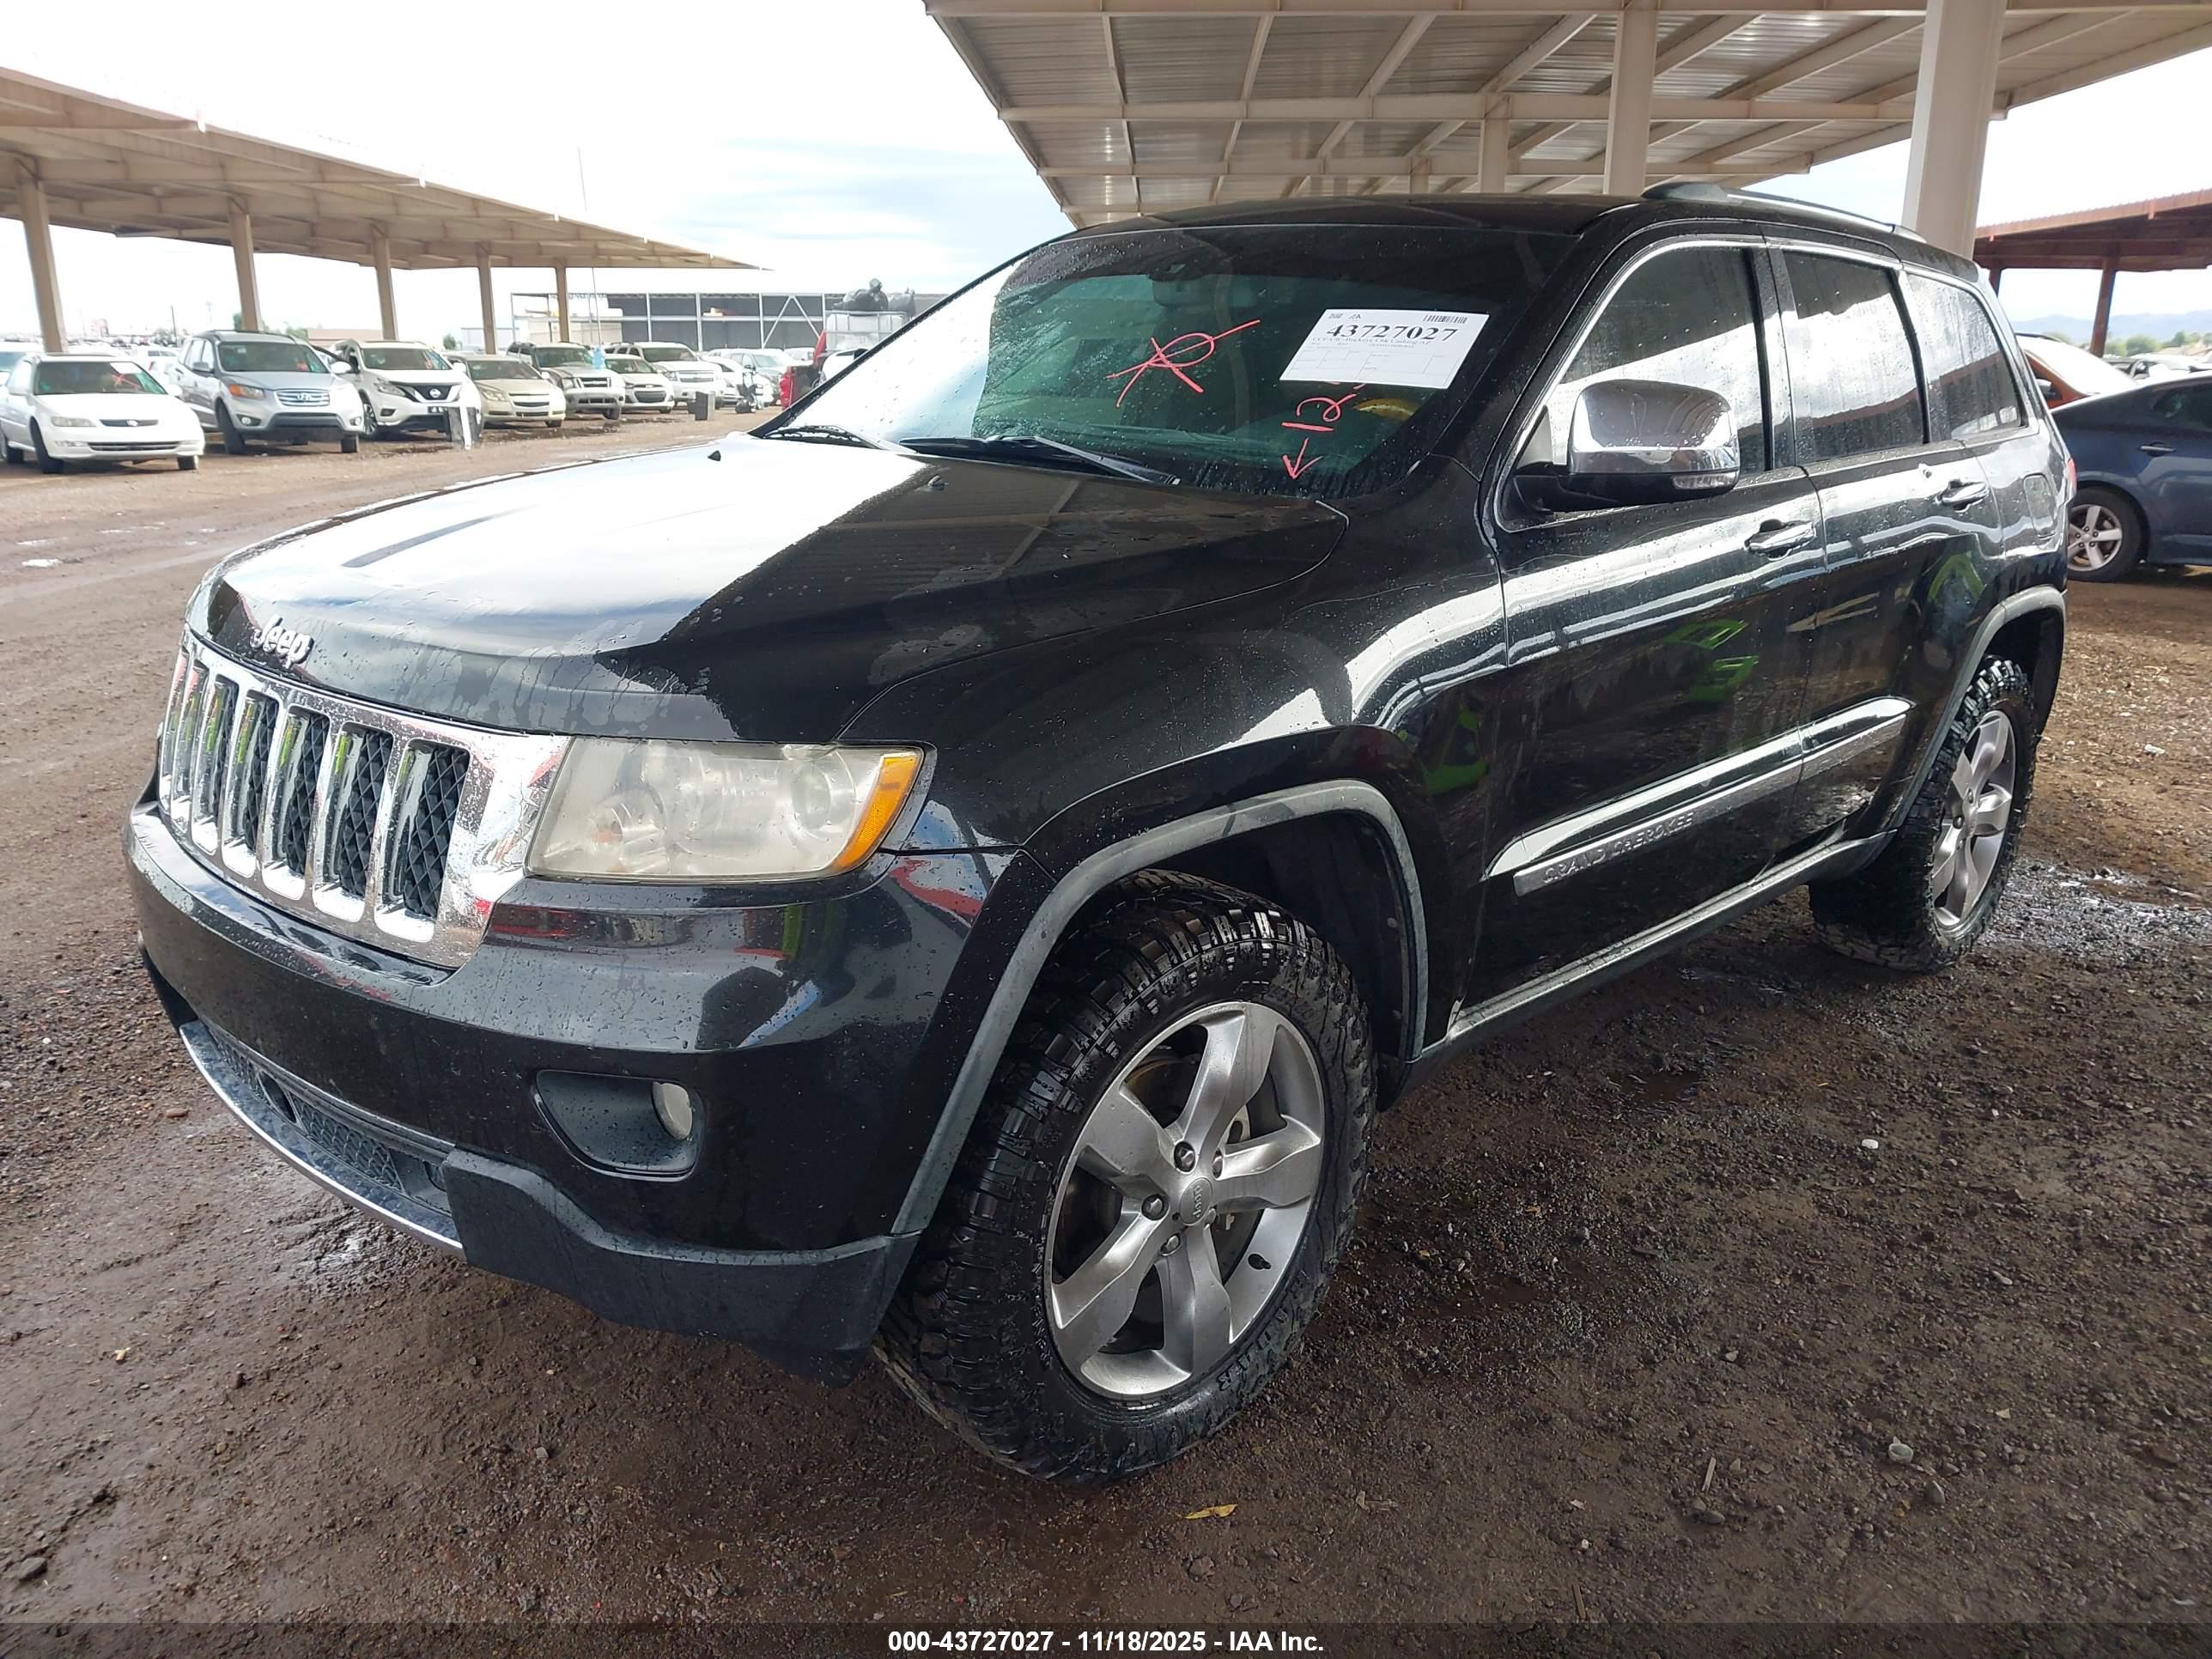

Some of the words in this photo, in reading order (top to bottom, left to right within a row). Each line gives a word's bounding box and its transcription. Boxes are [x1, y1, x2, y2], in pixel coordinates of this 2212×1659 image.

[1327, 324, 1459, 342] 43727027
[250, 614, 314, 671] Jeep
[1544, 848, 1606, 883] GRAND
[1611, 811, 1694, 857] CHEROKEE
